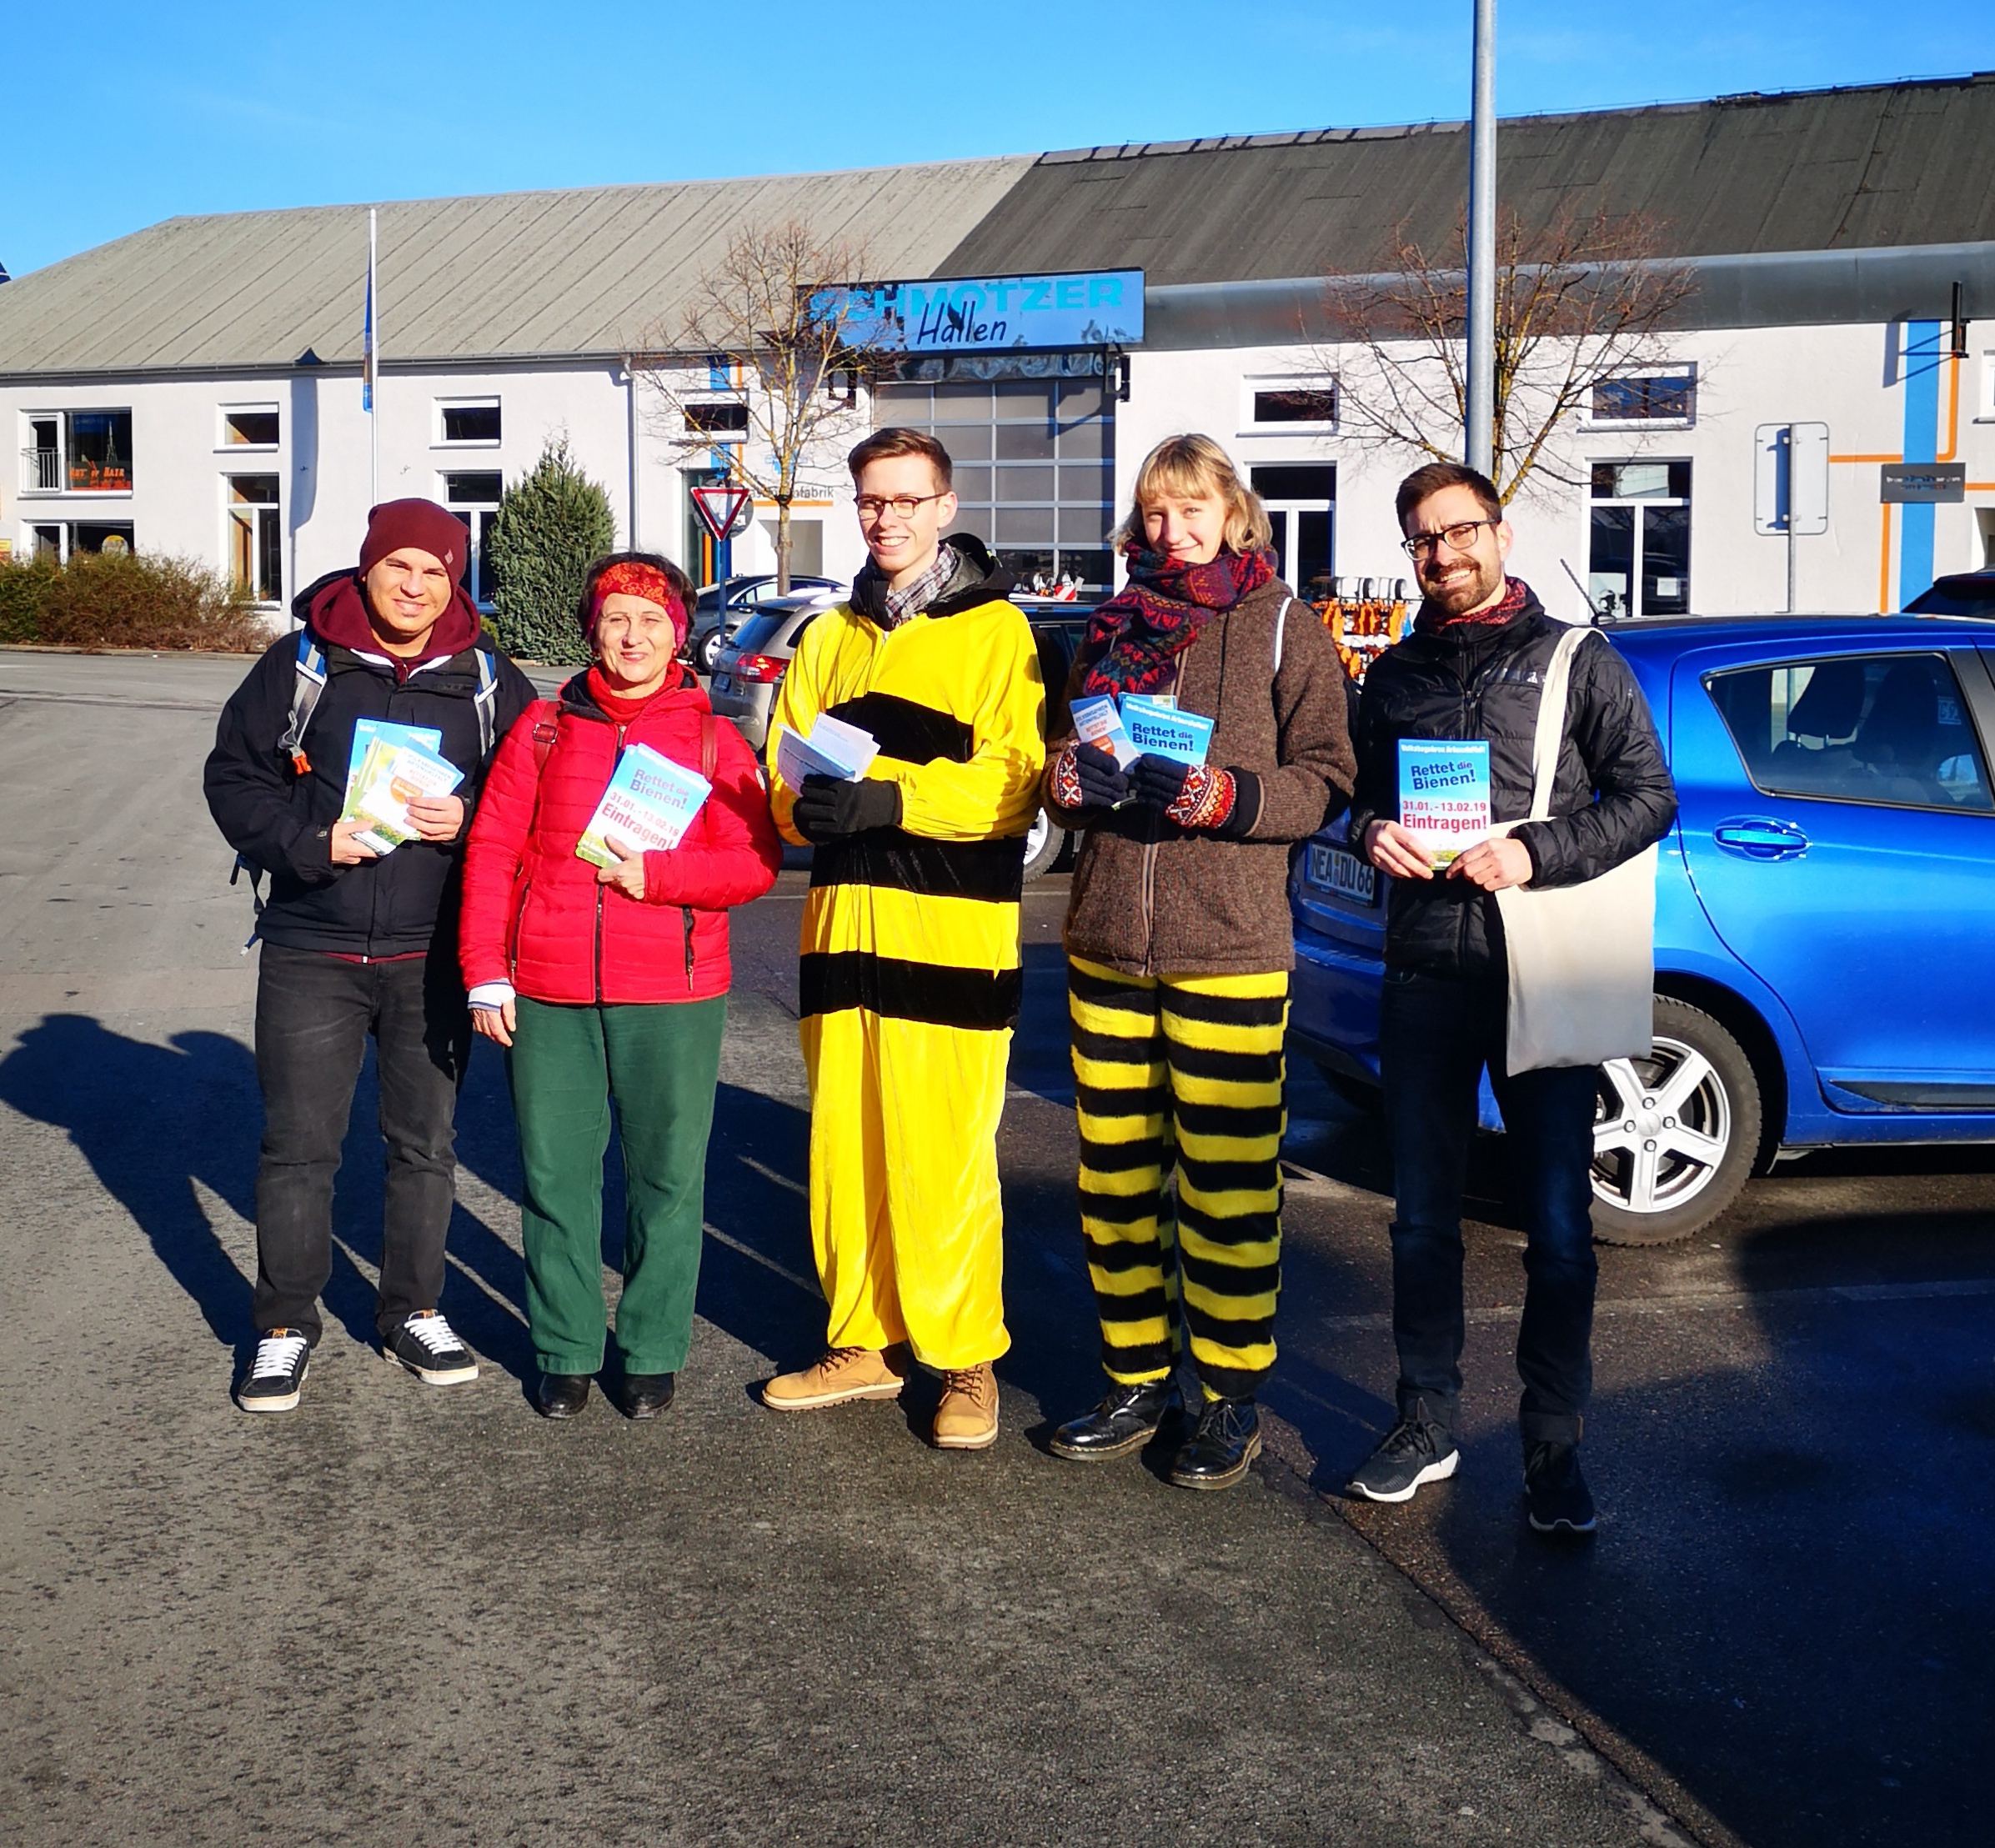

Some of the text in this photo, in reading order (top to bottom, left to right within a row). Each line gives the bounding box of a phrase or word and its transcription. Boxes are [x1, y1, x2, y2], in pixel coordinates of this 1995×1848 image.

[810, 278, 1124, 322] SCHMOTZER
[917, 300, 1007, 346] Hallen
[1132, 723, 1176, 739] Rettet
[1132, 733, 1194, 752] Bienen!
[634, 768, 690, 798] Rettet die
[1411, 761, 1472, 777] Rettet die
[1413, 769, 1476, 790] Bienen!
[629, 778, 689, 810] Bienen!
[601, 802, 674, 849] Eintragen!
[1403, 814, 1487, 833] Eintragen!
[1312, 848, 1332, 883] NEA
